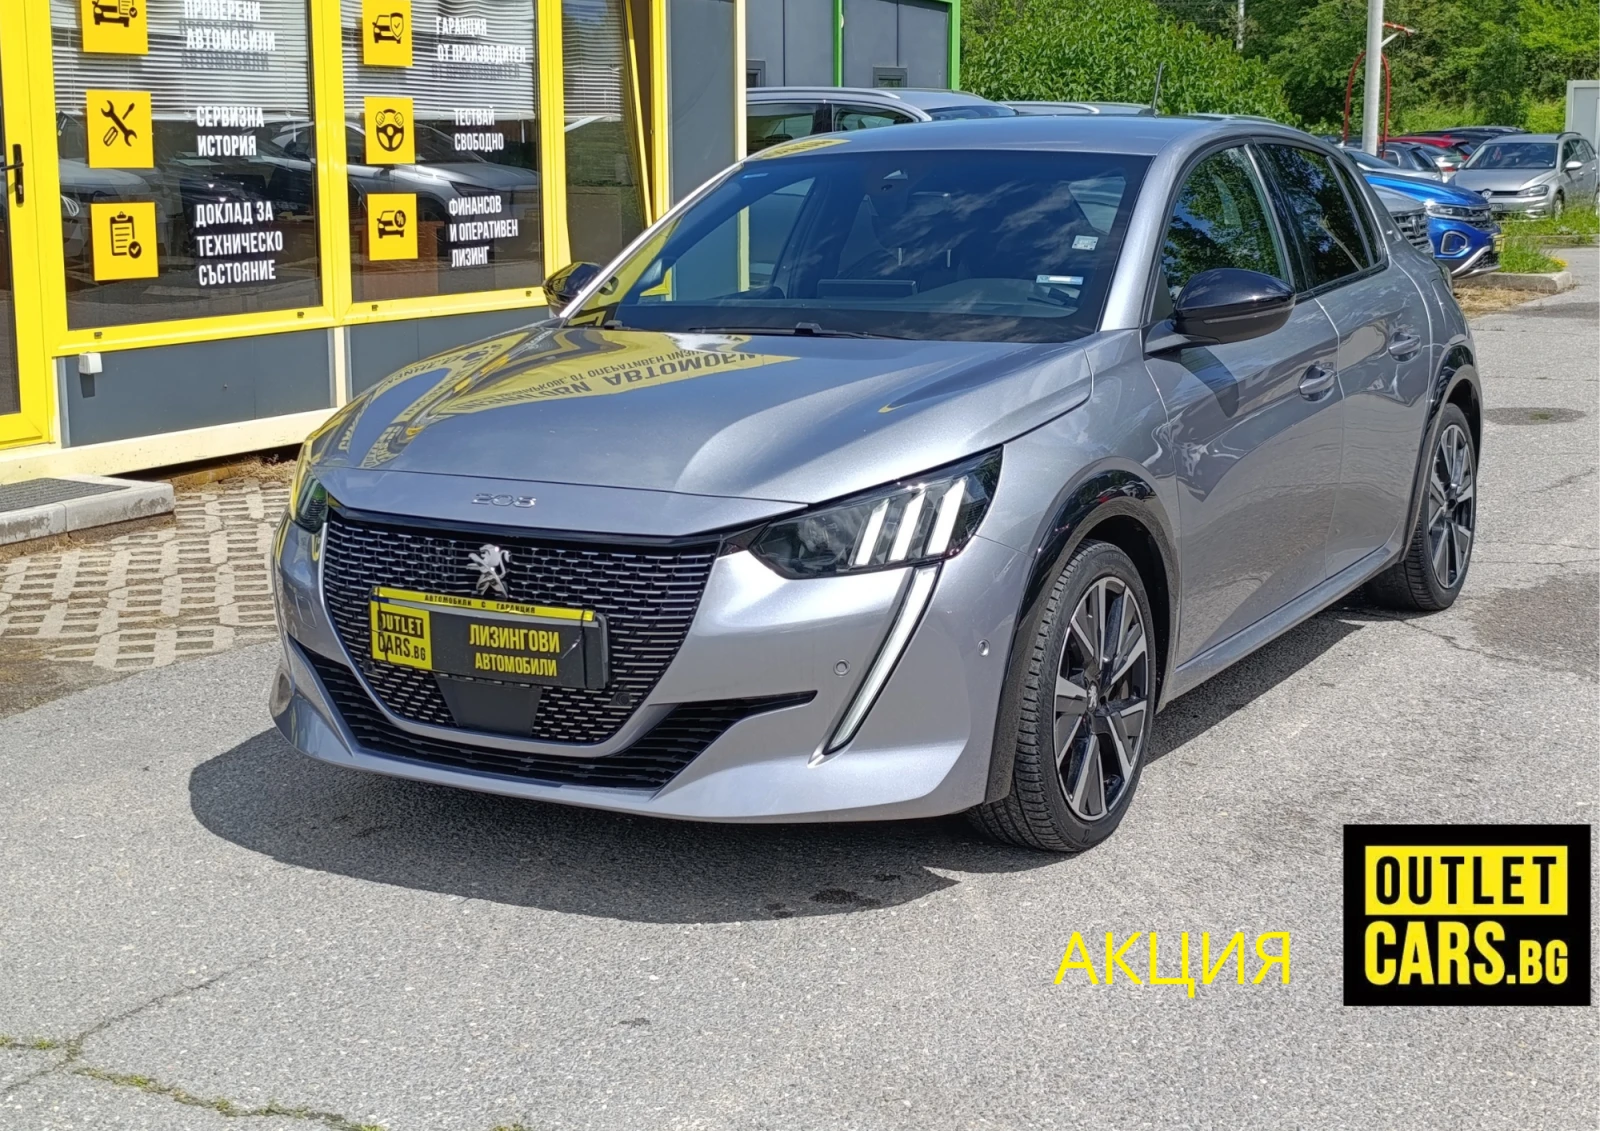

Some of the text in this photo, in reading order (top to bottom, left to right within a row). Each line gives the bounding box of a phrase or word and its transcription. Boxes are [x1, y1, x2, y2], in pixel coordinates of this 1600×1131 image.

[184, 0, 261, 21] ПРОВЕРЕНИ
[436, 16, 487, 36] ГАРАНЦИЯ
[186, 28, 276, 51] АВТОМОБИЛИ
[437, 44, 526, 65] ОТ ПРОИЗВОДИТЕЛ
[196, 106, 265, 128] СЕРВИЗНА
[453, 105, 495, 126] ТЕСТВАЙ
[197, 135, 257, 157] ИСТОРИЯ
[454, 132, 505, 153] СВОБОДНО
[195, 201, 274, 228] ДОКЛАД ЗА
[448, 195, 502, 217] ФИНАНСОВ
[449, 219, 519, 242] И ОПЕРАТИВЕН
[196, 231, 284, 257] ТЕХНИЧЕСКО
[451, 246, 490, 268] ЛИЗИНГ
[198, 260, 277, 286] СЪСТОЯНИЕ
[471, 493, 537, 508] 208
[424, 594, 472, 606] АВТОМОБИЛИ
[469, 623, 560, 653] ЛИЗИНГОВИ
[475, 652, 558, 676] АВТОМОБИЛИ
